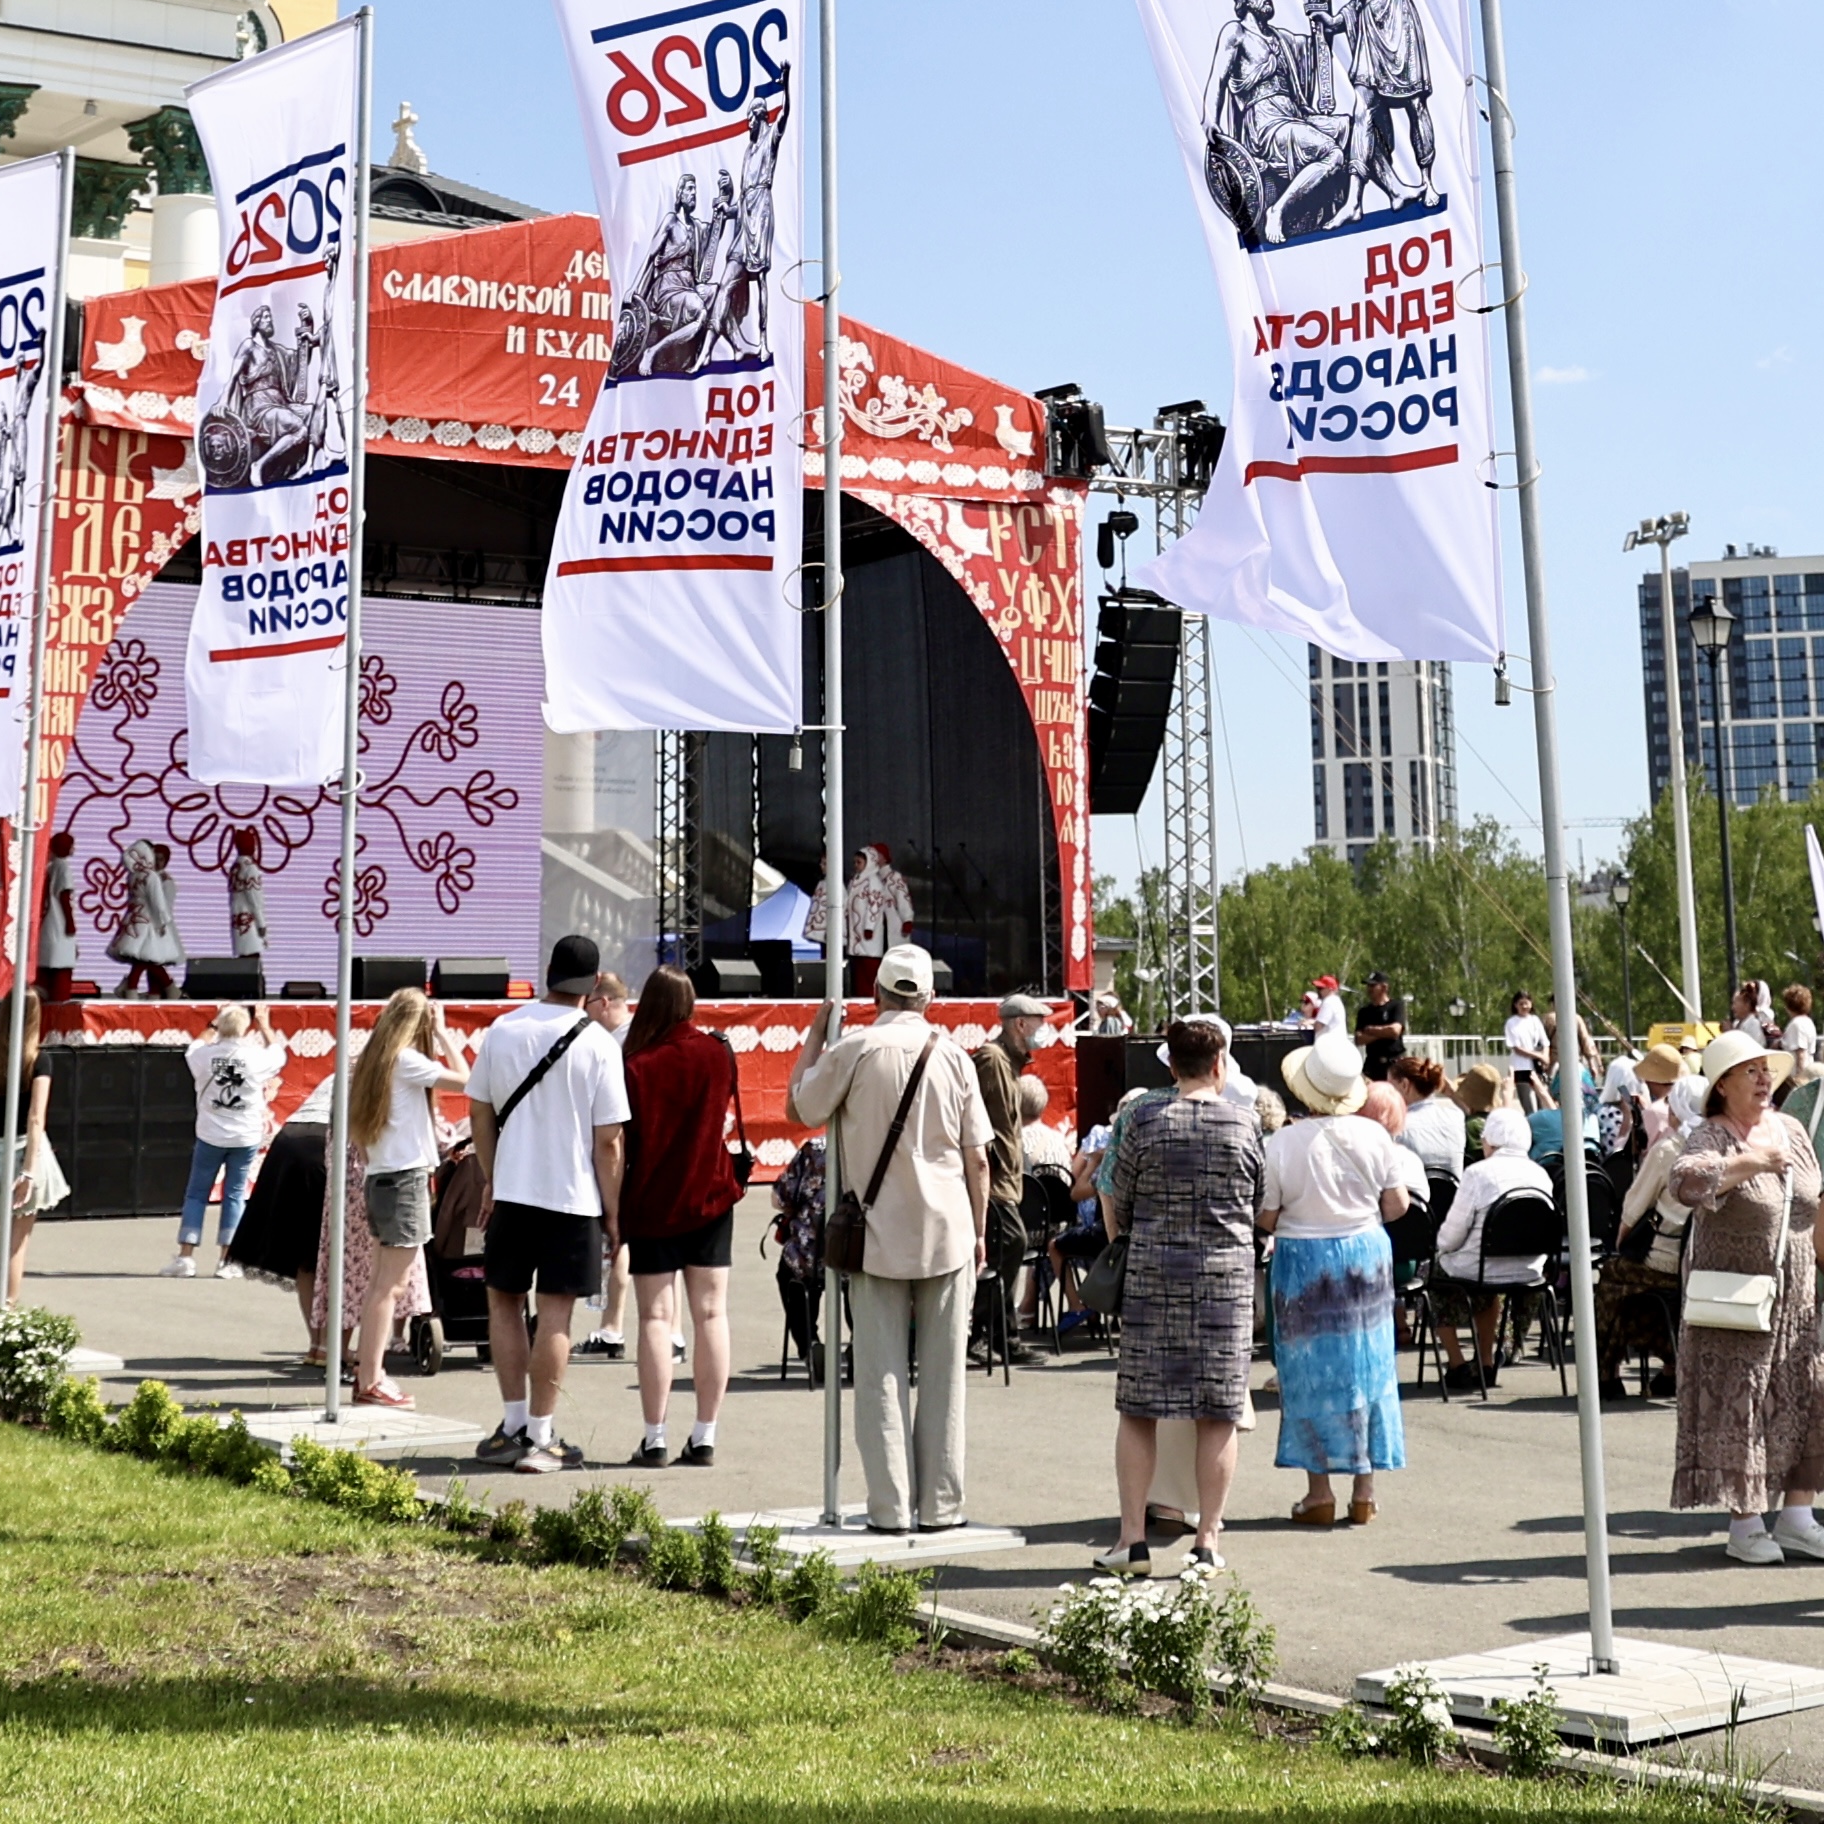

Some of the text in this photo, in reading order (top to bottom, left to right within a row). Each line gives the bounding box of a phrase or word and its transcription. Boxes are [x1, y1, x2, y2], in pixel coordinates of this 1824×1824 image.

[383, 269, 572, 317] СЛАВЯНСКОЙ
[506, 325, 526, 354] И
[538, 373, 580, 408] 24
